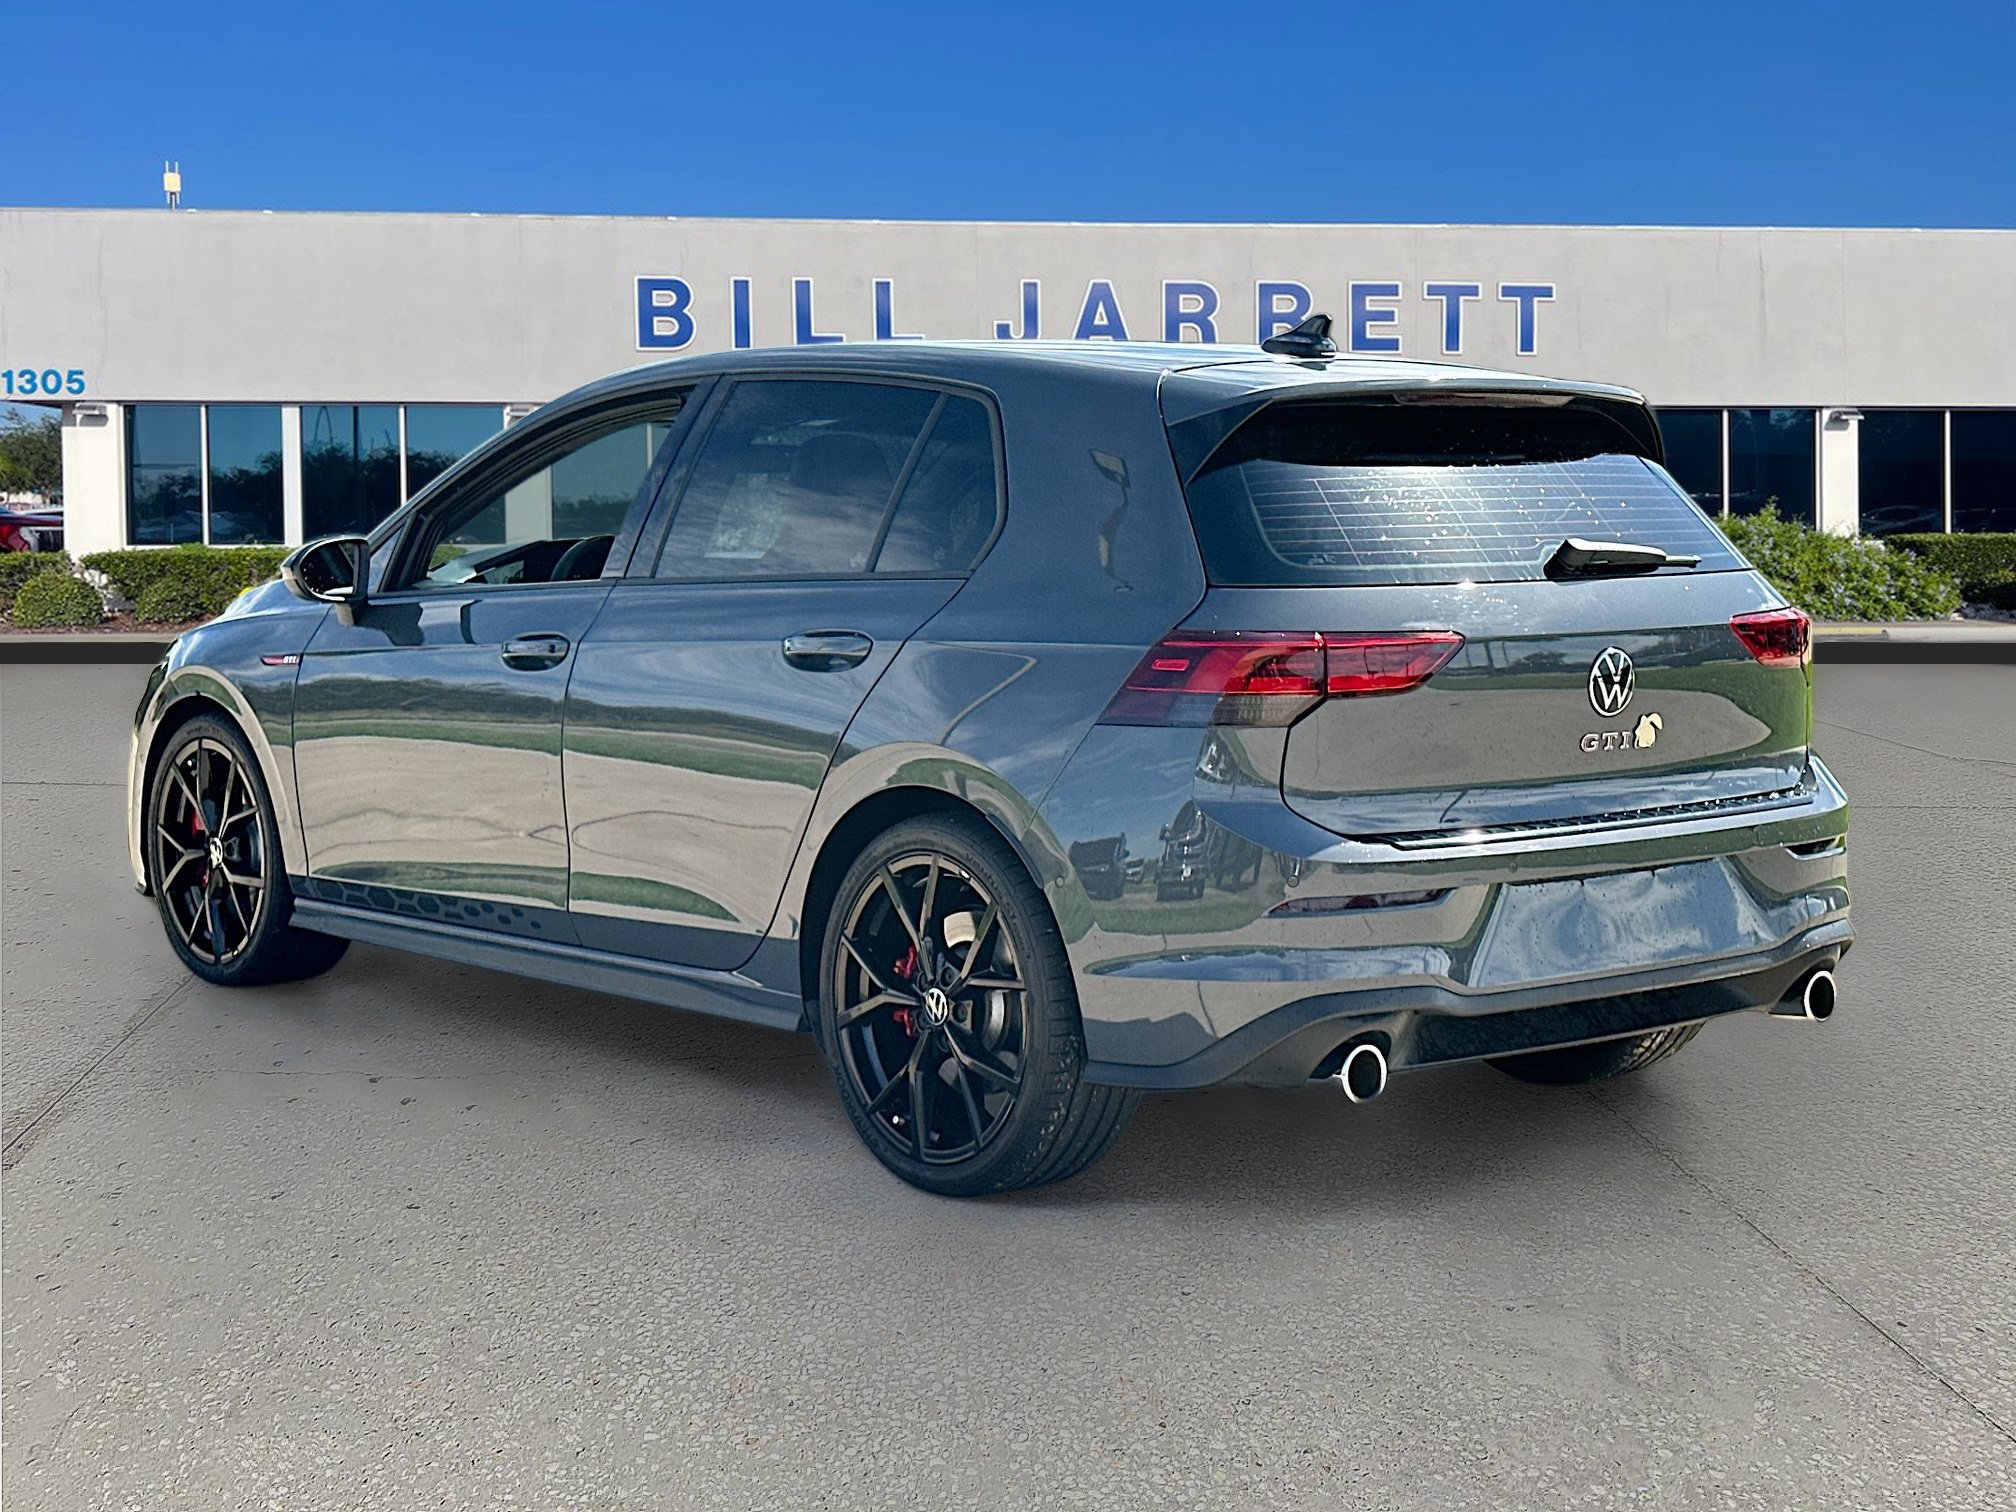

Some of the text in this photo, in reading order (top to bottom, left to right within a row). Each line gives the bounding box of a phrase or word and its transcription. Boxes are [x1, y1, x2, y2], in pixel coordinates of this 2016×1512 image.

[634, 275, 1556, 356] BILL JARRETT
[1, 368, 86, 396] 1305
[1580, 731, 1631, 752] GTI
